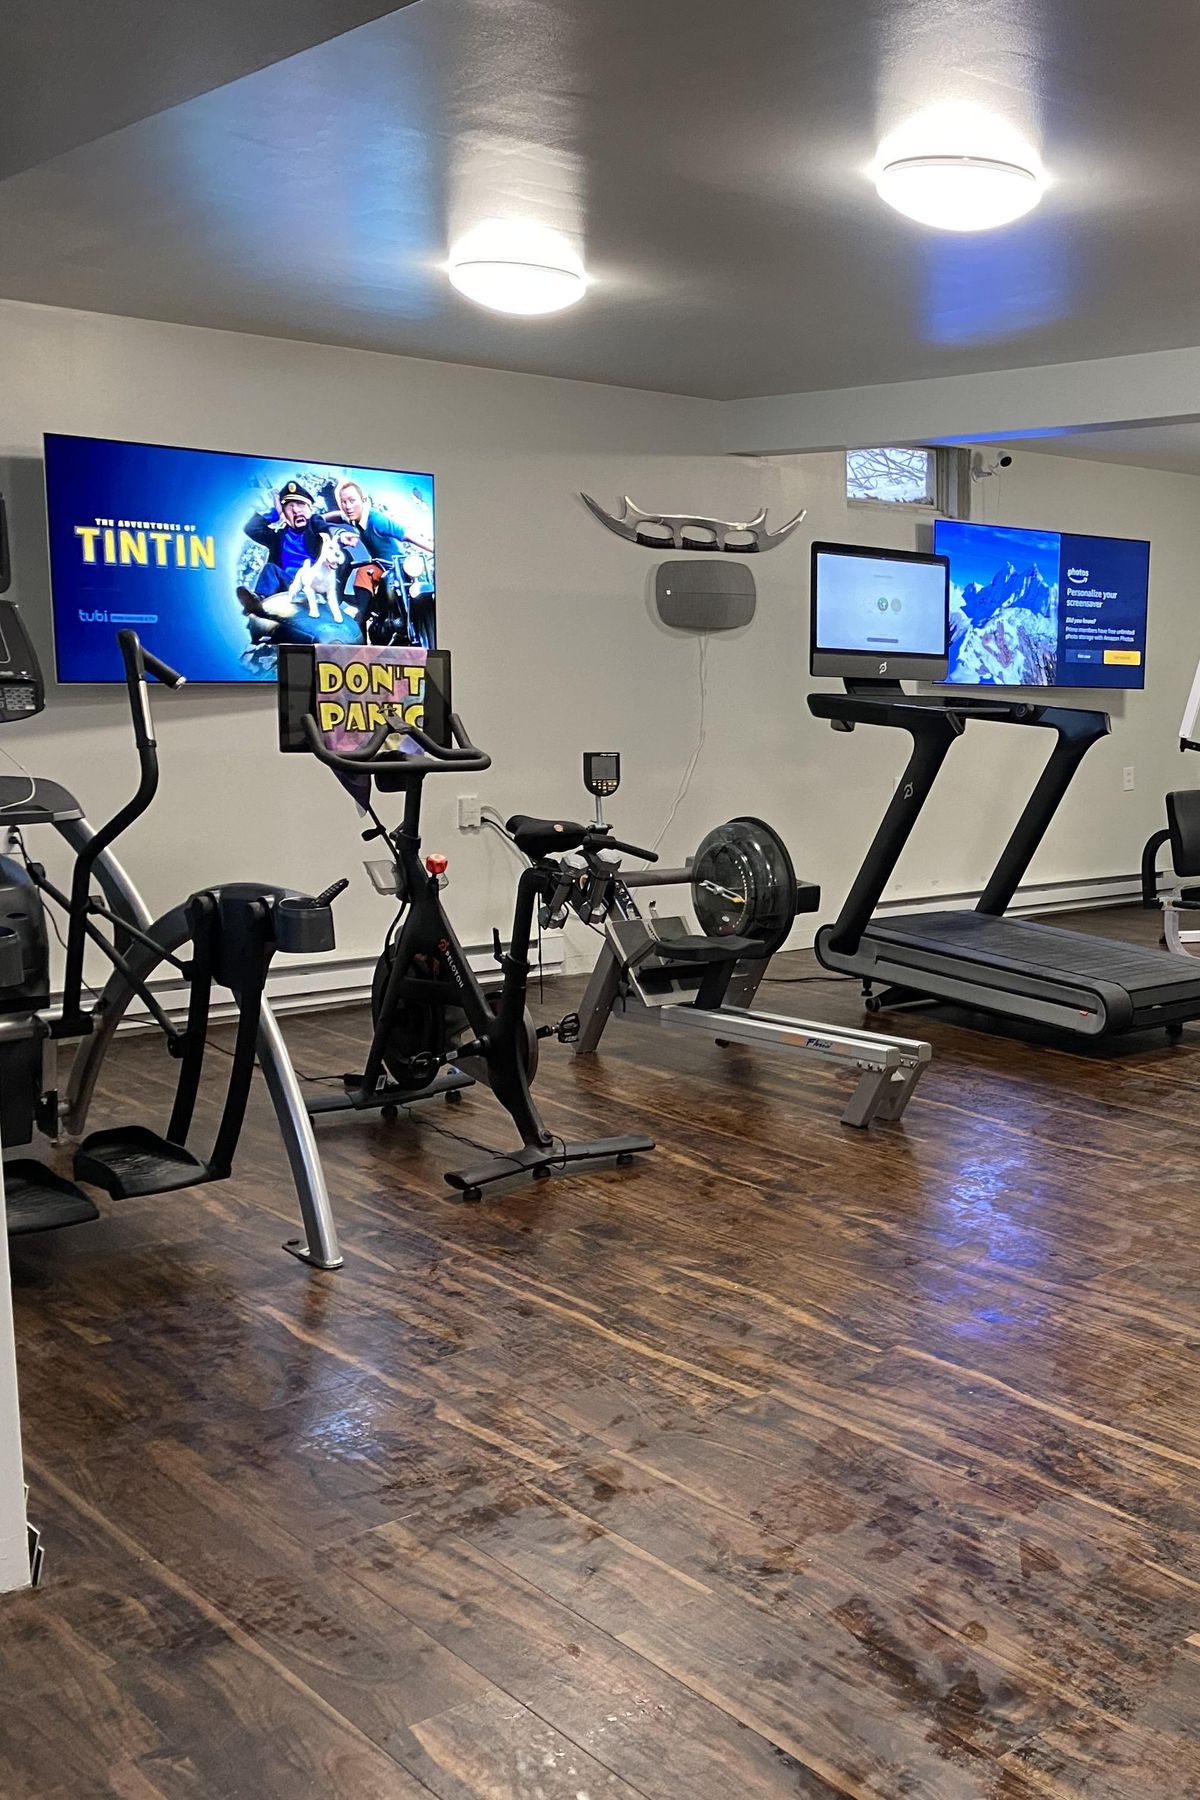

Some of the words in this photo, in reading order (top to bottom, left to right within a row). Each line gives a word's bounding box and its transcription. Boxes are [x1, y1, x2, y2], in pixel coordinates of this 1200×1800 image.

[94, 517, 115, 527] THE
[117, 519, 181, 531] ADVENTURES
[183, 524, 197, 532] OF
[74, 525, 216, 570] TINTIN
[1067, 588, 1102, 598] Personalize
[1102, 592, 1117, 600] your
[1066, 600, 1103, 608] screensaver
[78, 608, 108, 623] tubi
[318, 660, 425, 697] DON'T
[445, 950, 465, 989] PELOTON
